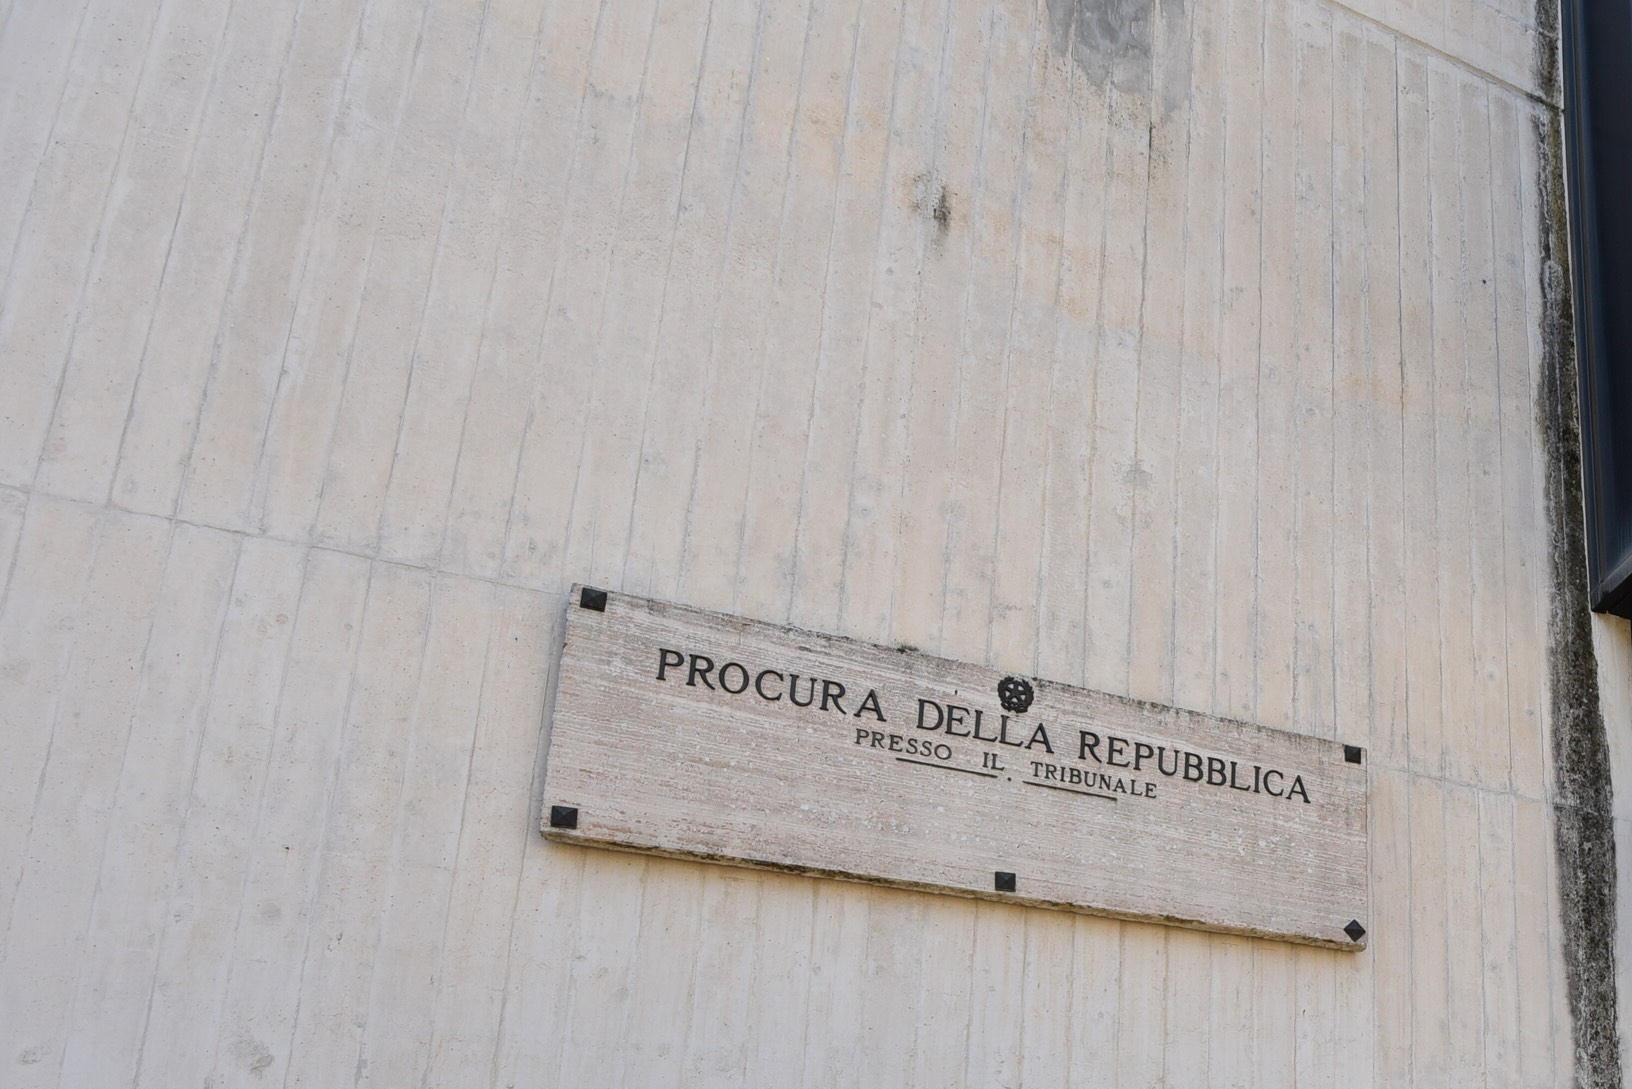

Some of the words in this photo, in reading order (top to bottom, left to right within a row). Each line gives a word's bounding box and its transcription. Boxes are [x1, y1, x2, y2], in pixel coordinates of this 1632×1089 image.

[655, 647, 888, 723] PROCURA
[916, 698, 1055, 755] DELLA
[1077, 730, 1312, 804] REPUBBLICA
[854, 728, 953, 761] PRESSO
[982, 751, 1006, 771] IL
[1030, 761, 1158, 799] TRIBUNALE
